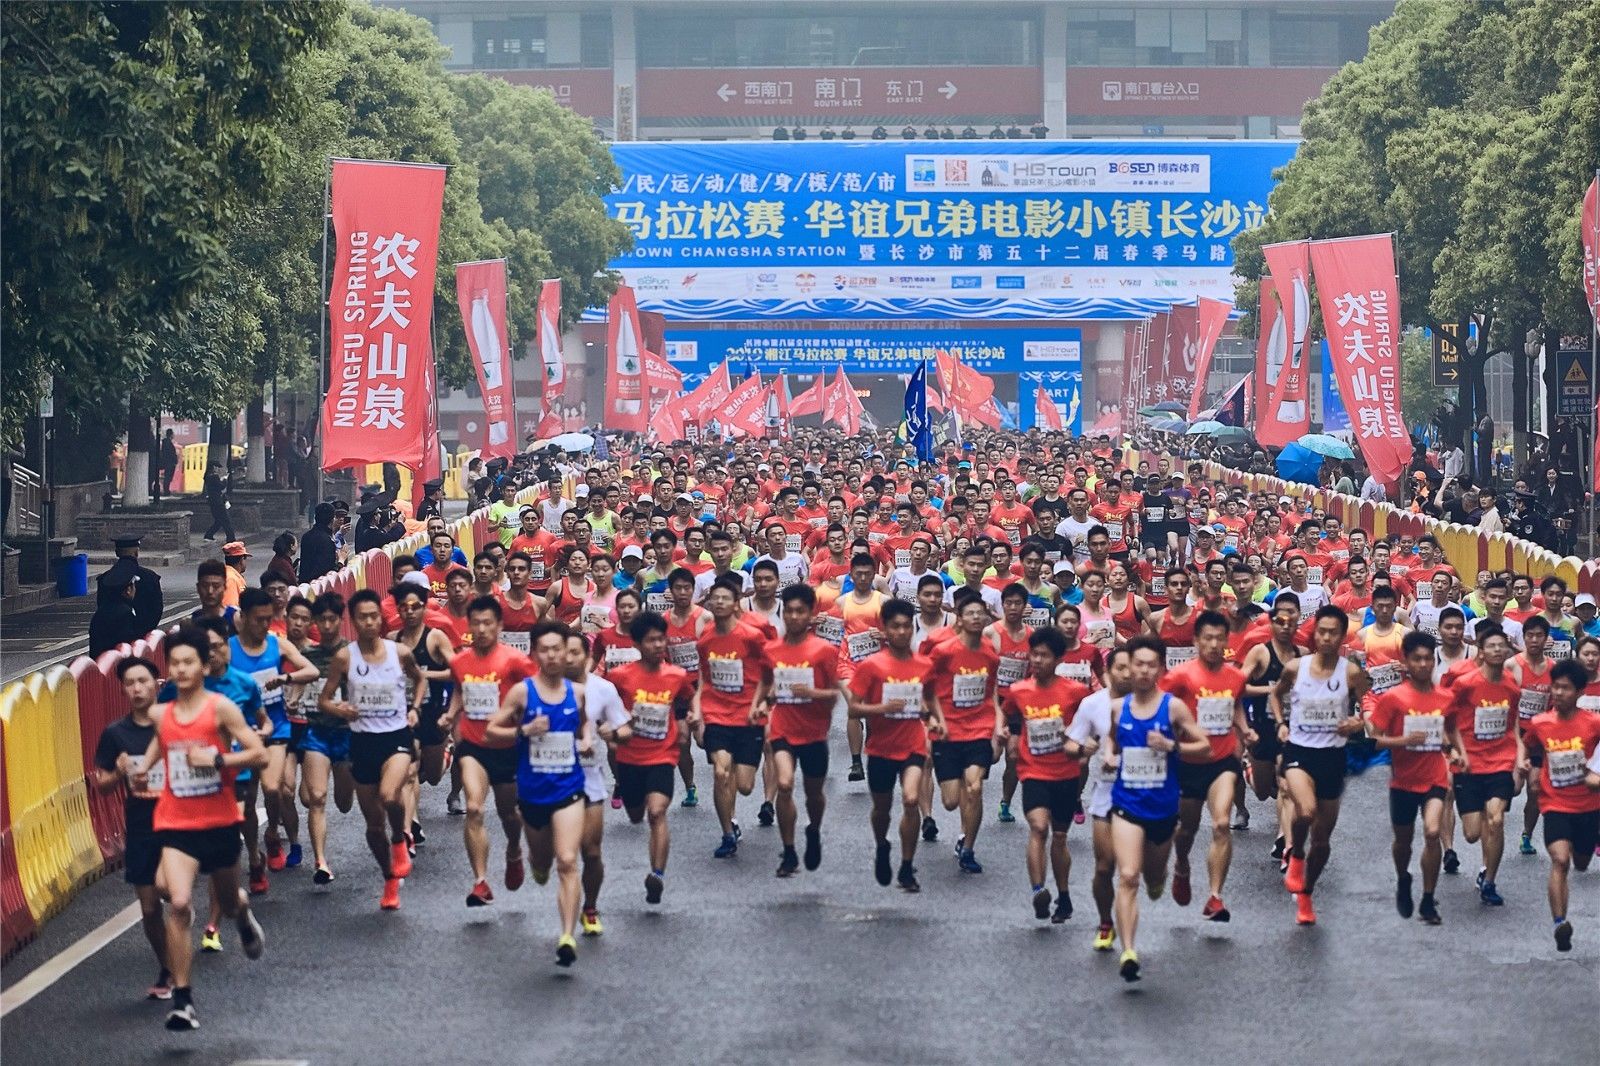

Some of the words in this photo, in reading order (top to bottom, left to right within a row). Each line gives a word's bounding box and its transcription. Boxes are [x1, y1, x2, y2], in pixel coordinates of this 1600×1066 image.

[745, 81, 793, 98] 西南门
[814, 77, 861, 99] 南门
[886, 80, 924, 96] 东门
[1125, 82, 1200, 95] 南门看台入口
[814, 99, 840, 107] SOUTH
[842, 99, 863, 107] GATE
[1157, 162, 1200, 174] 博森体育
[681, 246, 772, 257] CHANGSHA
[776, 246, 847, 257] STATION
[343, 231, 369, 323] SPRING
[360, 231, 421, 430] 农夫山泉
[333, 333, 364, 427] NONGFU
[1032, 388, 1070, 398] SART
